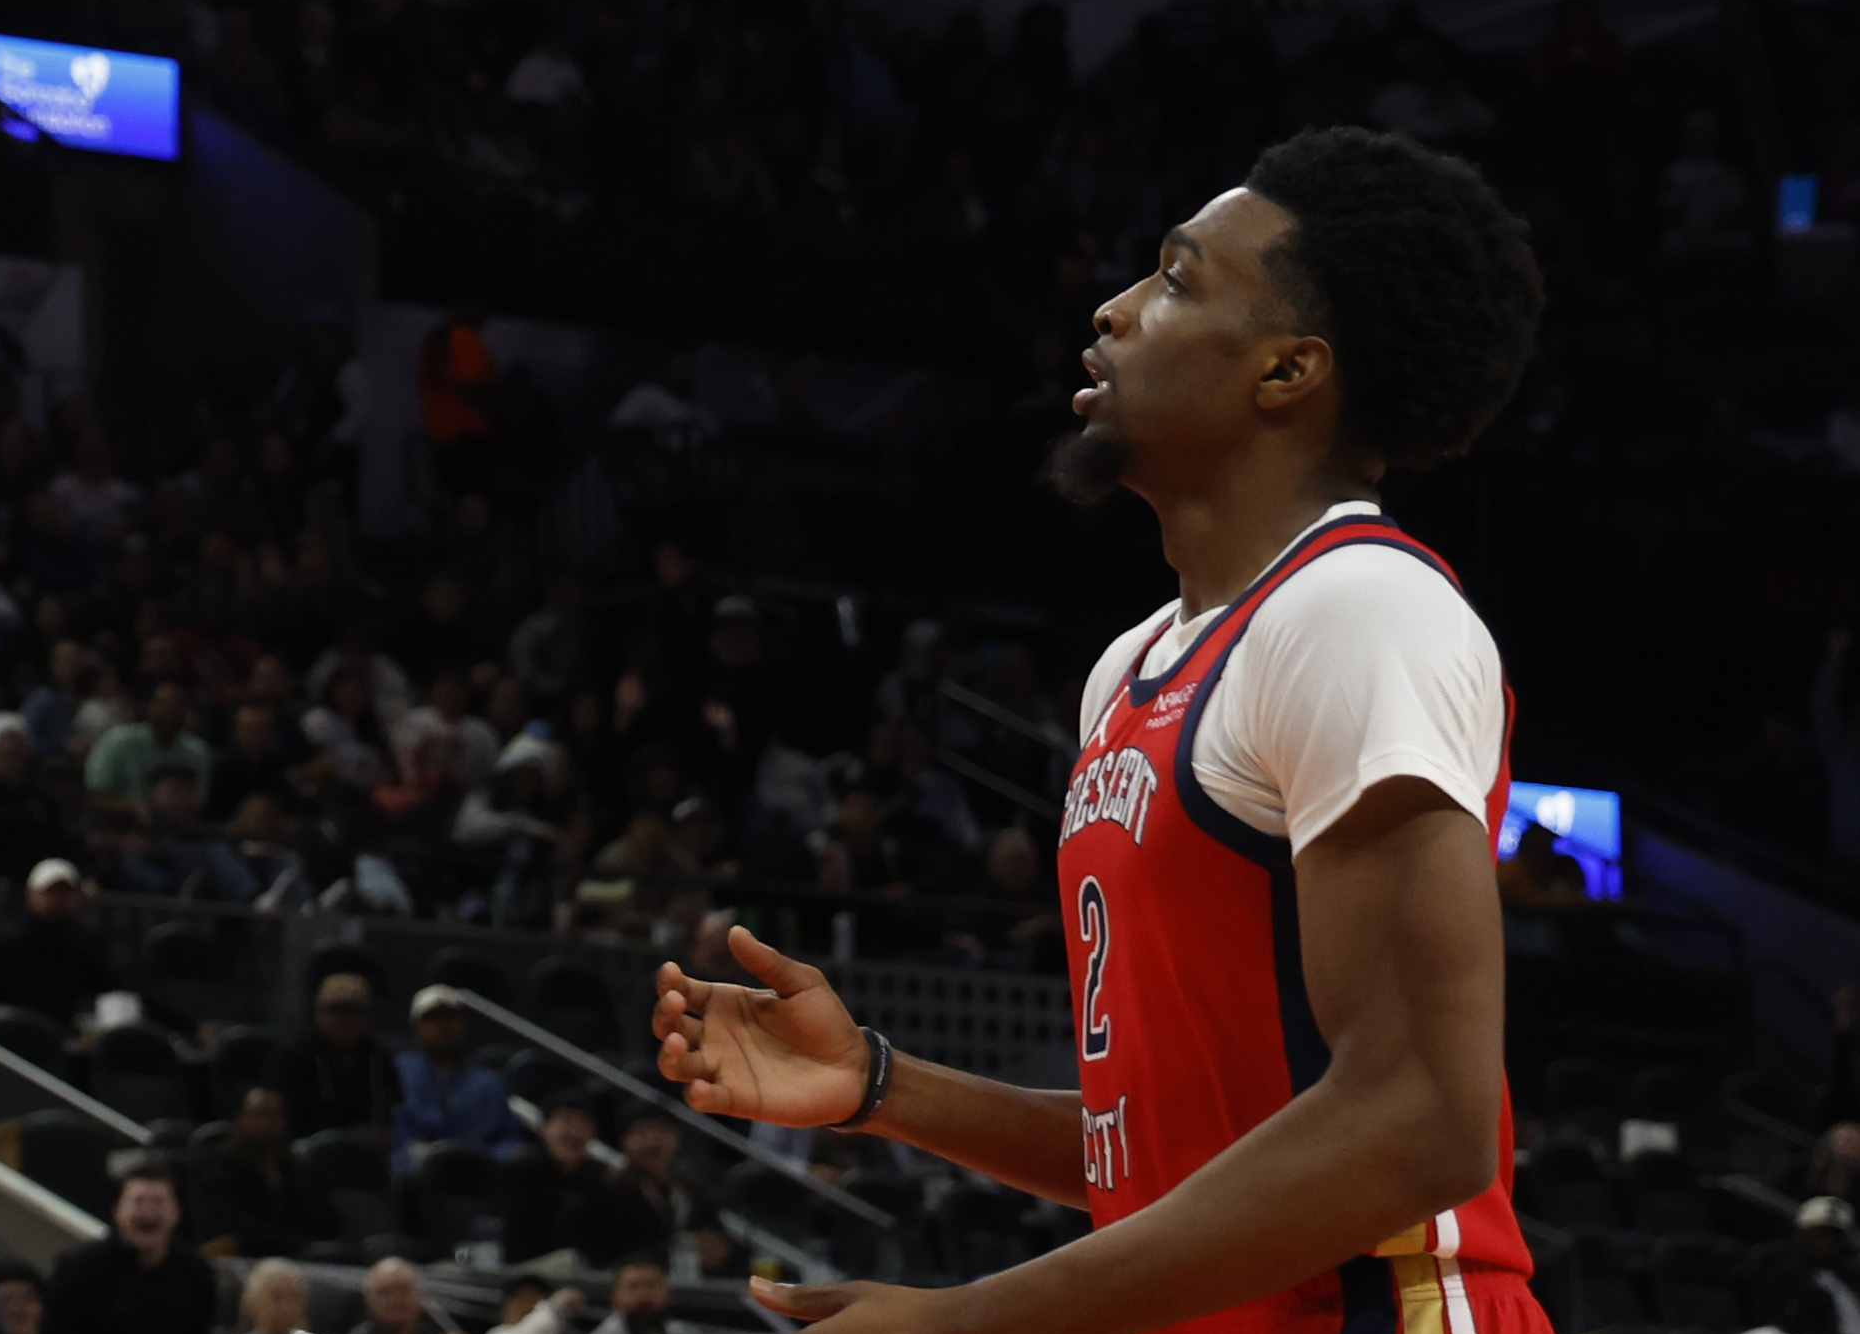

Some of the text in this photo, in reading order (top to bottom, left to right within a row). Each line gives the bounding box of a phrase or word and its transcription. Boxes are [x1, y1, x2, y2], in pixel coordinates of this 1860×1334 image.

[1058, 746, 1158, 848] RESCENT
[1079, 875, 1109, 1061] 2
[1082, 1094, 1130, 1190] CITY
